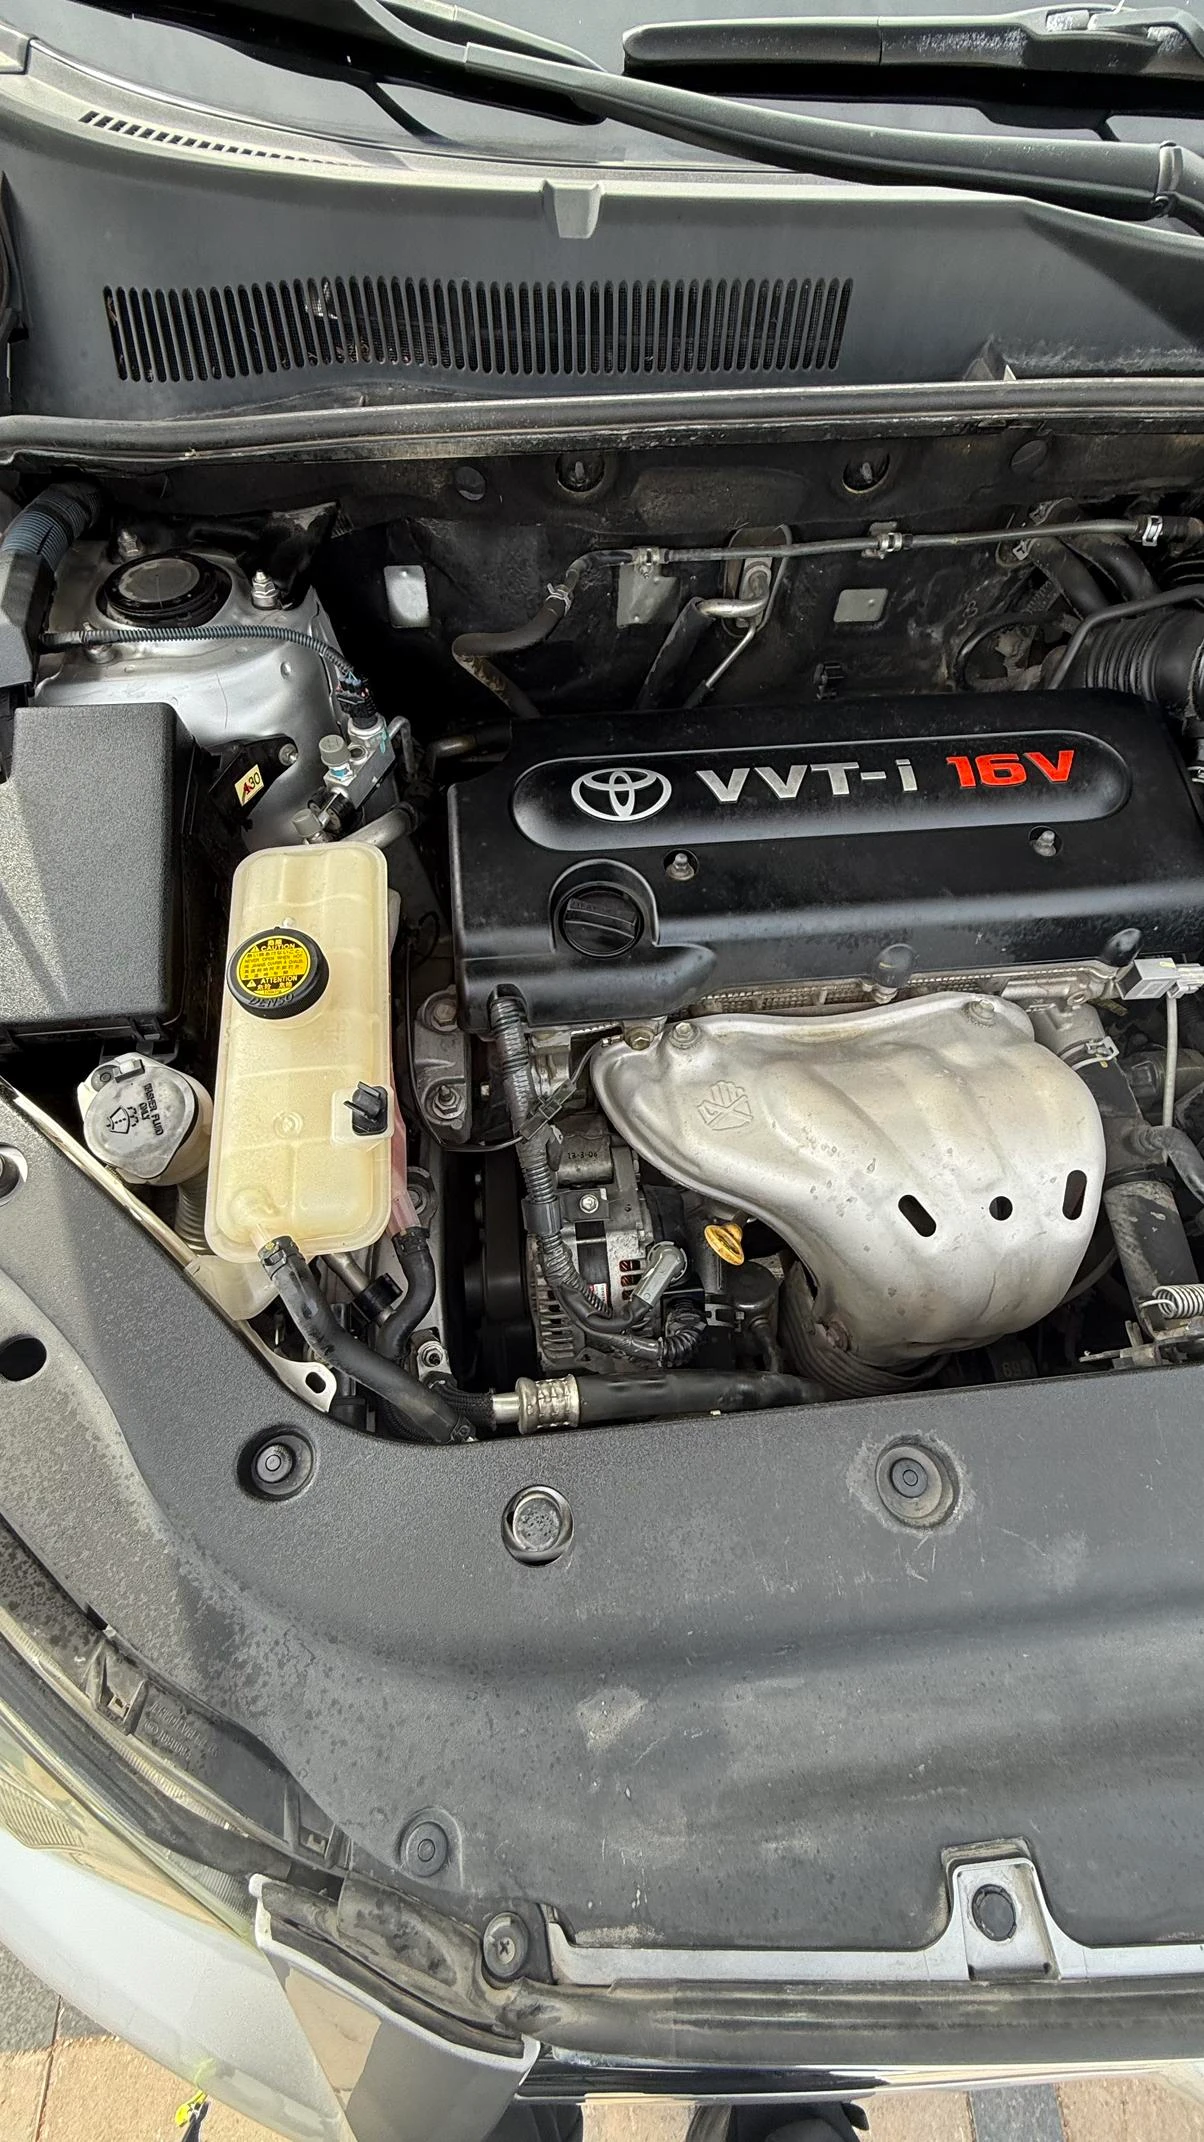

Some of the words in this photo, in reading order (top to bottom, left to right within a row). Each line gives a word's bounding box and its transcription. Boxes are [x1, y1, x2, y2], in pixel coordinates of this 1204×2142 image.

[696, 759, 920, 802] VVT-i
[946, 749, 1075, 789] 16V
[260, 943, 295, 951] CAUTION
[260, 975, 297, 984] ATTENTION
[249, 993, 294, 1007] DENSO
[139, 1102, 151, 1120] ONLY
[144, 1083, 157, 1111] WASHER
[151, 1114, 163, 1135] FLUID
